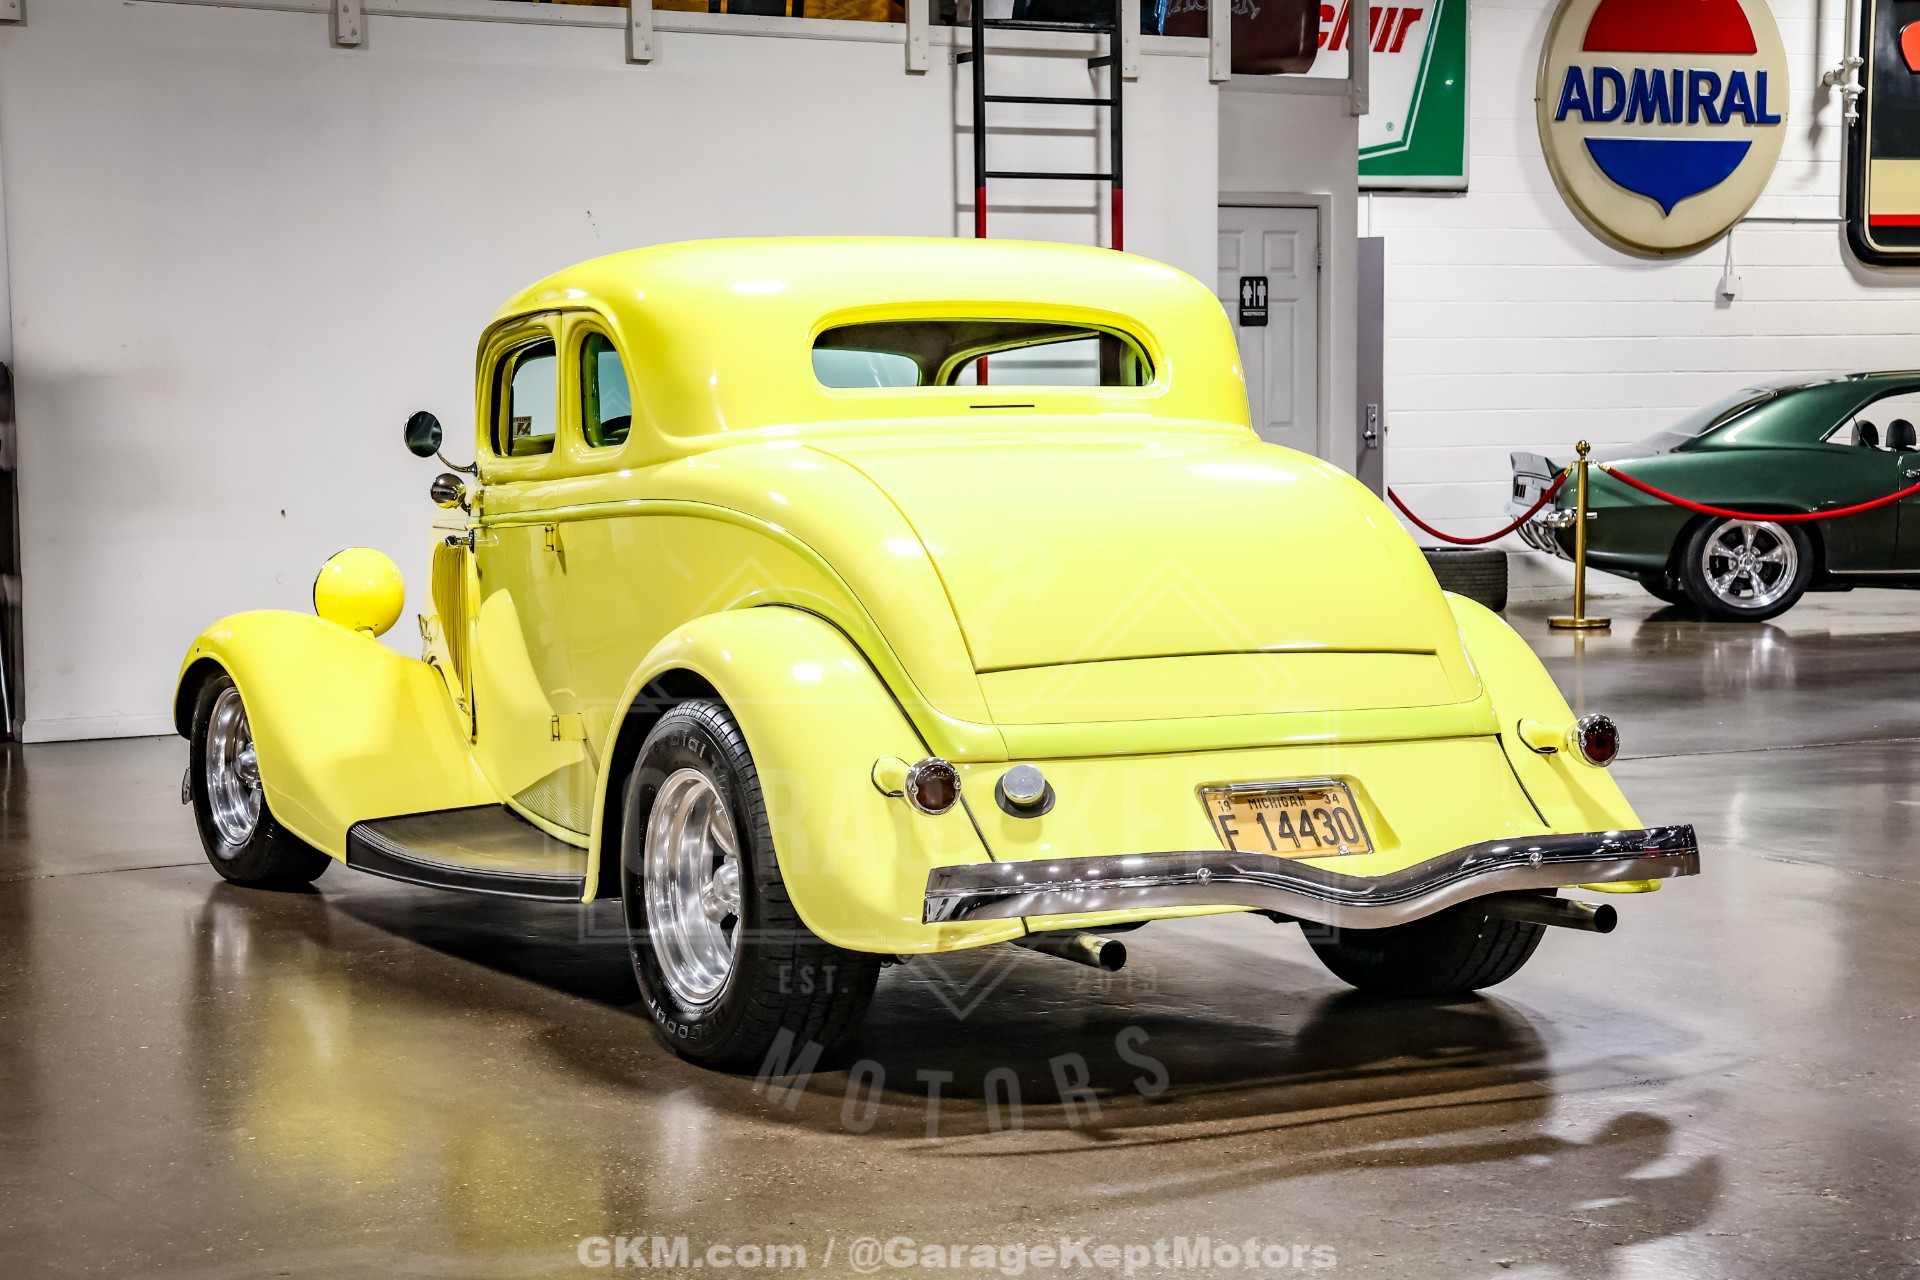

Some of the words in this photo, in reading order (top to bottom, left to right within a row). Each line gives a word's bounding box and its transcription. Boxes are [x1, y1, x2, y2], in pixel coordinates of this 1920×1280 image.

[1555, 66, 1781, 124] ADMIRAL
[1218, 800, 1232, 812] 19
[1247, 795, 1307, 811] MICHIGAN
[1323, 793, 1340, 805] 34
[1218, 814, 1239, 852] F
[1257, 807, 1359, 851] 14430
